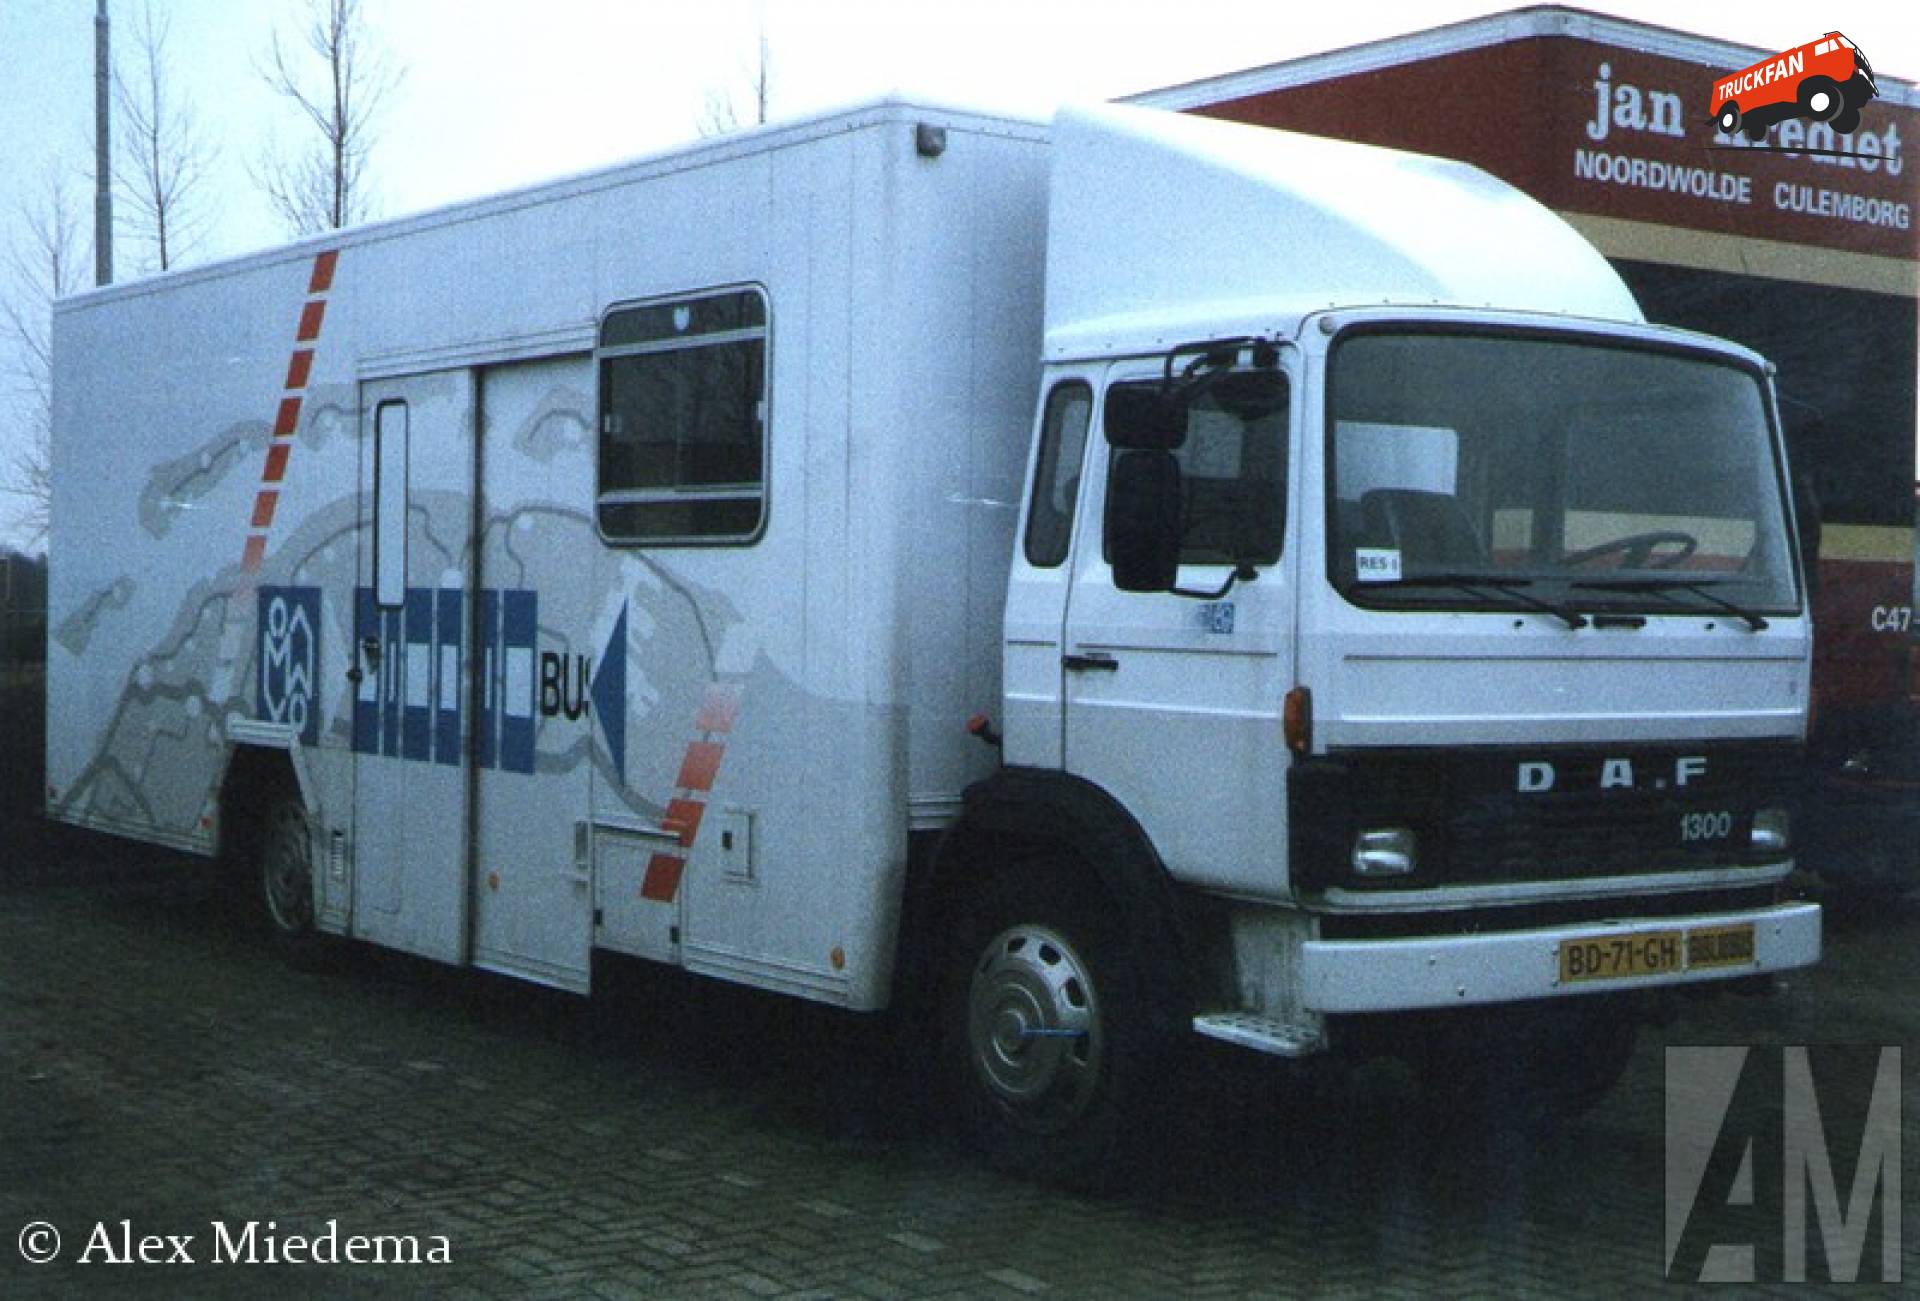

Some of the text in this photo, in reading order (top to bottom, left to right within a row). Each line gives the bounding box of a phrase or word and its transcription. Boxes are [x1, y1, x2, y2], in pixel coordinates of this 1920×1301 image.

[1586, 62, 1686, 140] jan
[1574, 149, 1910, 229] NOORDWOLDE CULEMBORG
[1871, 606, 1911, 632] C47
[1681, 810, 1732, 841] 1300
[1567, 937, 1677, 976] BD-71-GH
